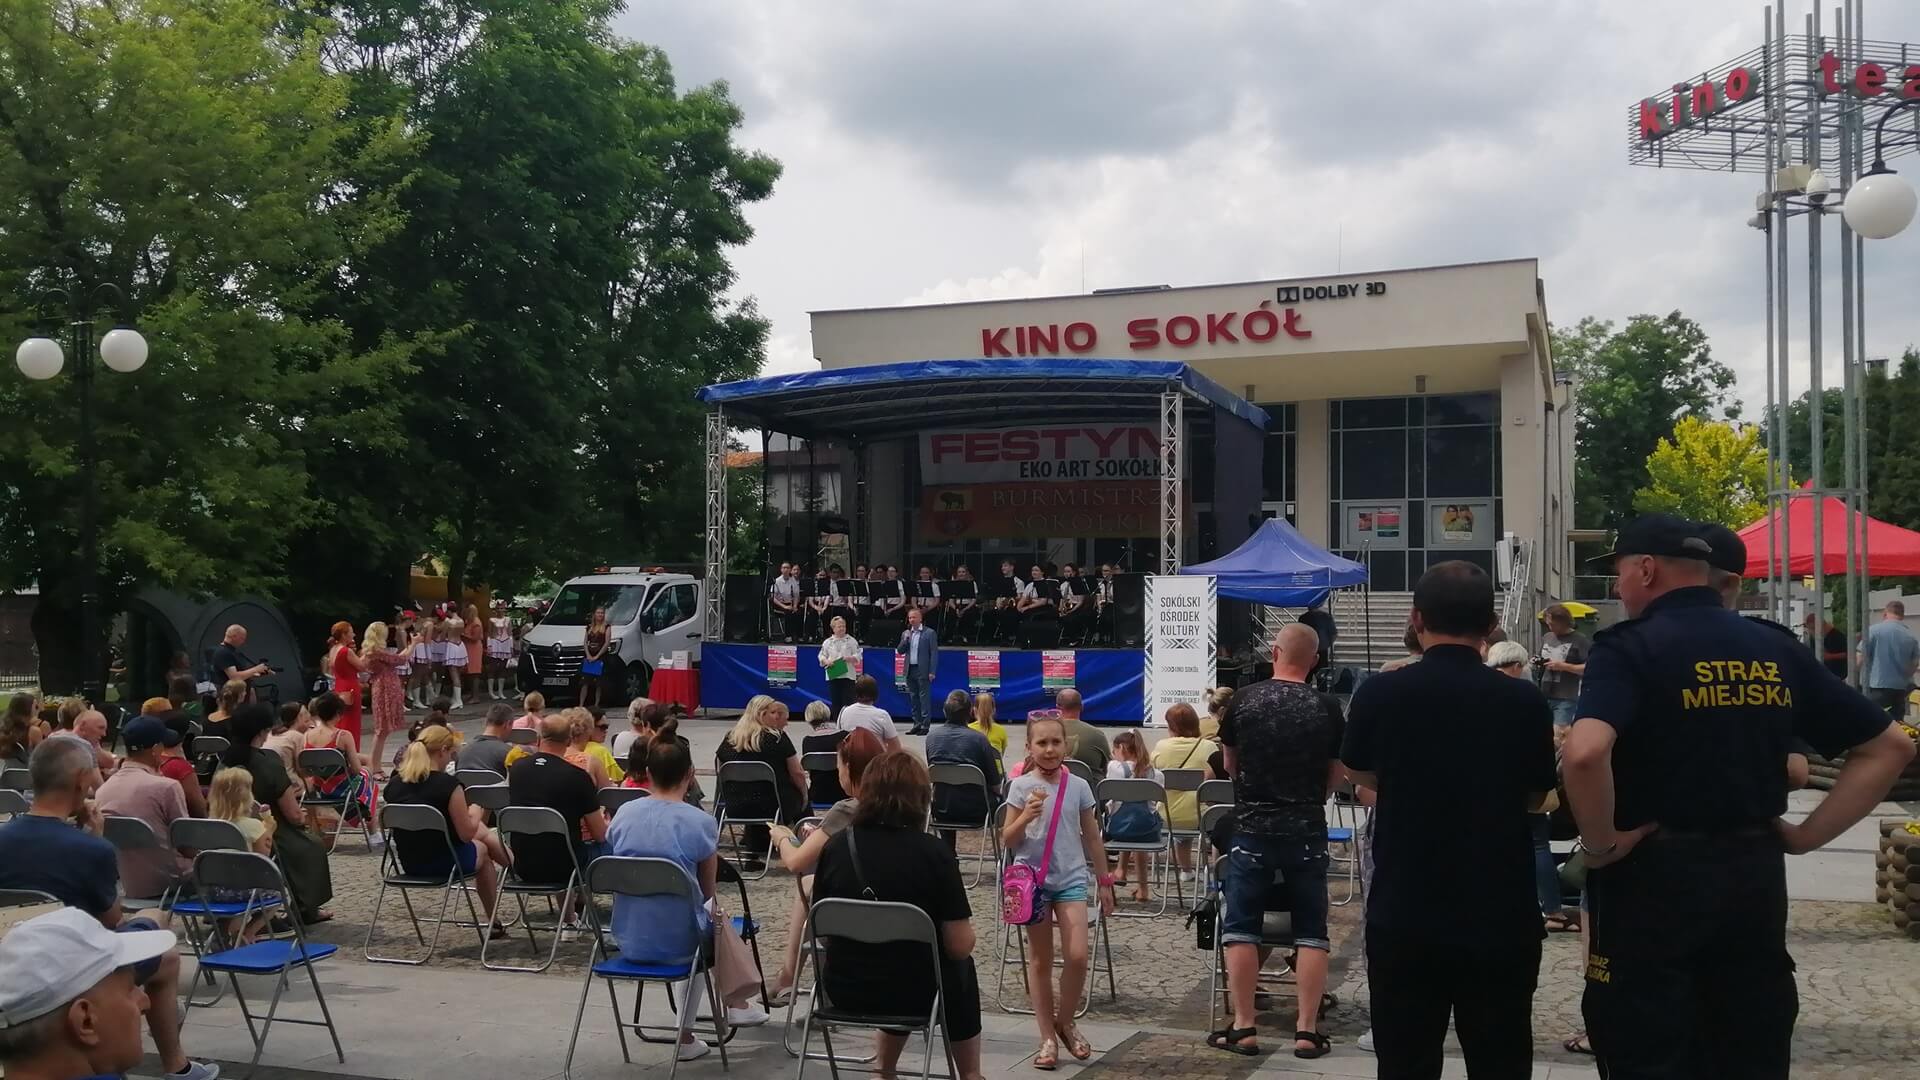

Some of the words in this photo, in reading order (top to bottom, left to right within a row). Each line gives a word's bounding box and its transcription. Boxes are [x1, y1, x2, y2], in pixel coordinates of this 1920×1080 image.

[1640, 66, 1756, 140] kino
[1303, 283, 1358, 301] DOLBY
[1366, 281, 1386, 297] 3D
[982, 321, 1098, 357] KINO
[1128, 300, 1312, 350] SOKÓŁ
[1020, 461, 1052, 478] EKO
[1057, 460, 1090, 477] ART
[1160, 593, 1200, 607] SOKÓLSKI
[1160, 608, 1200, 622] OŚRODEK
[1160, 625, 1200, 636] KULTURY
[1694, 660, 1783, 684] STRAŻ
[1682, 684, 1793, 710] MIEJSKA
